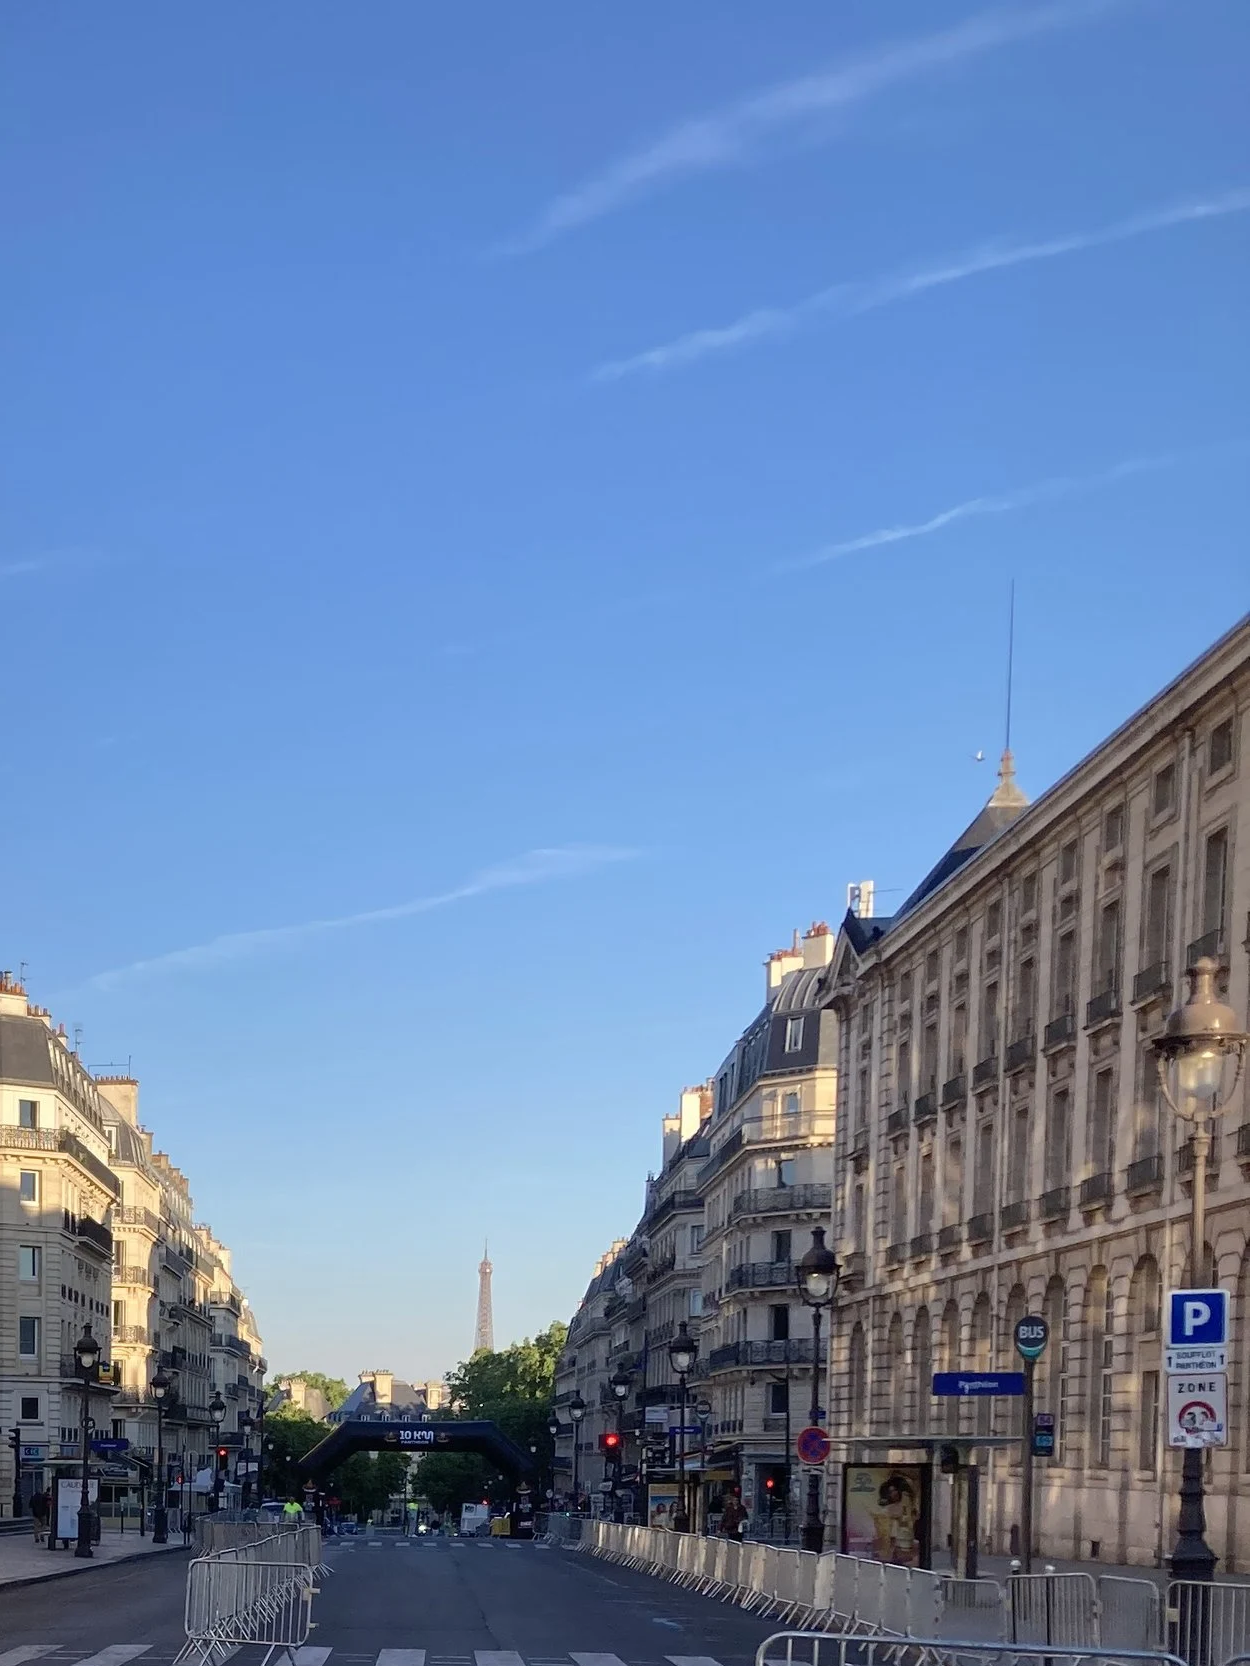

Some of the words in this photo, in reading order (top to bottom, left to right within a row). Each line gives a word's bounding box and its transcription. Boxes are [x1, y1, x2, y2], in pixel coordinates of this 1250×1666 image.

[1184, 1301, 1211, 1336] P
[1019, 1326, 1045, 1338] BUS
[1178, 1382, 1217, 1393] ZONE
[399, 1430, 411, 1440] 10
